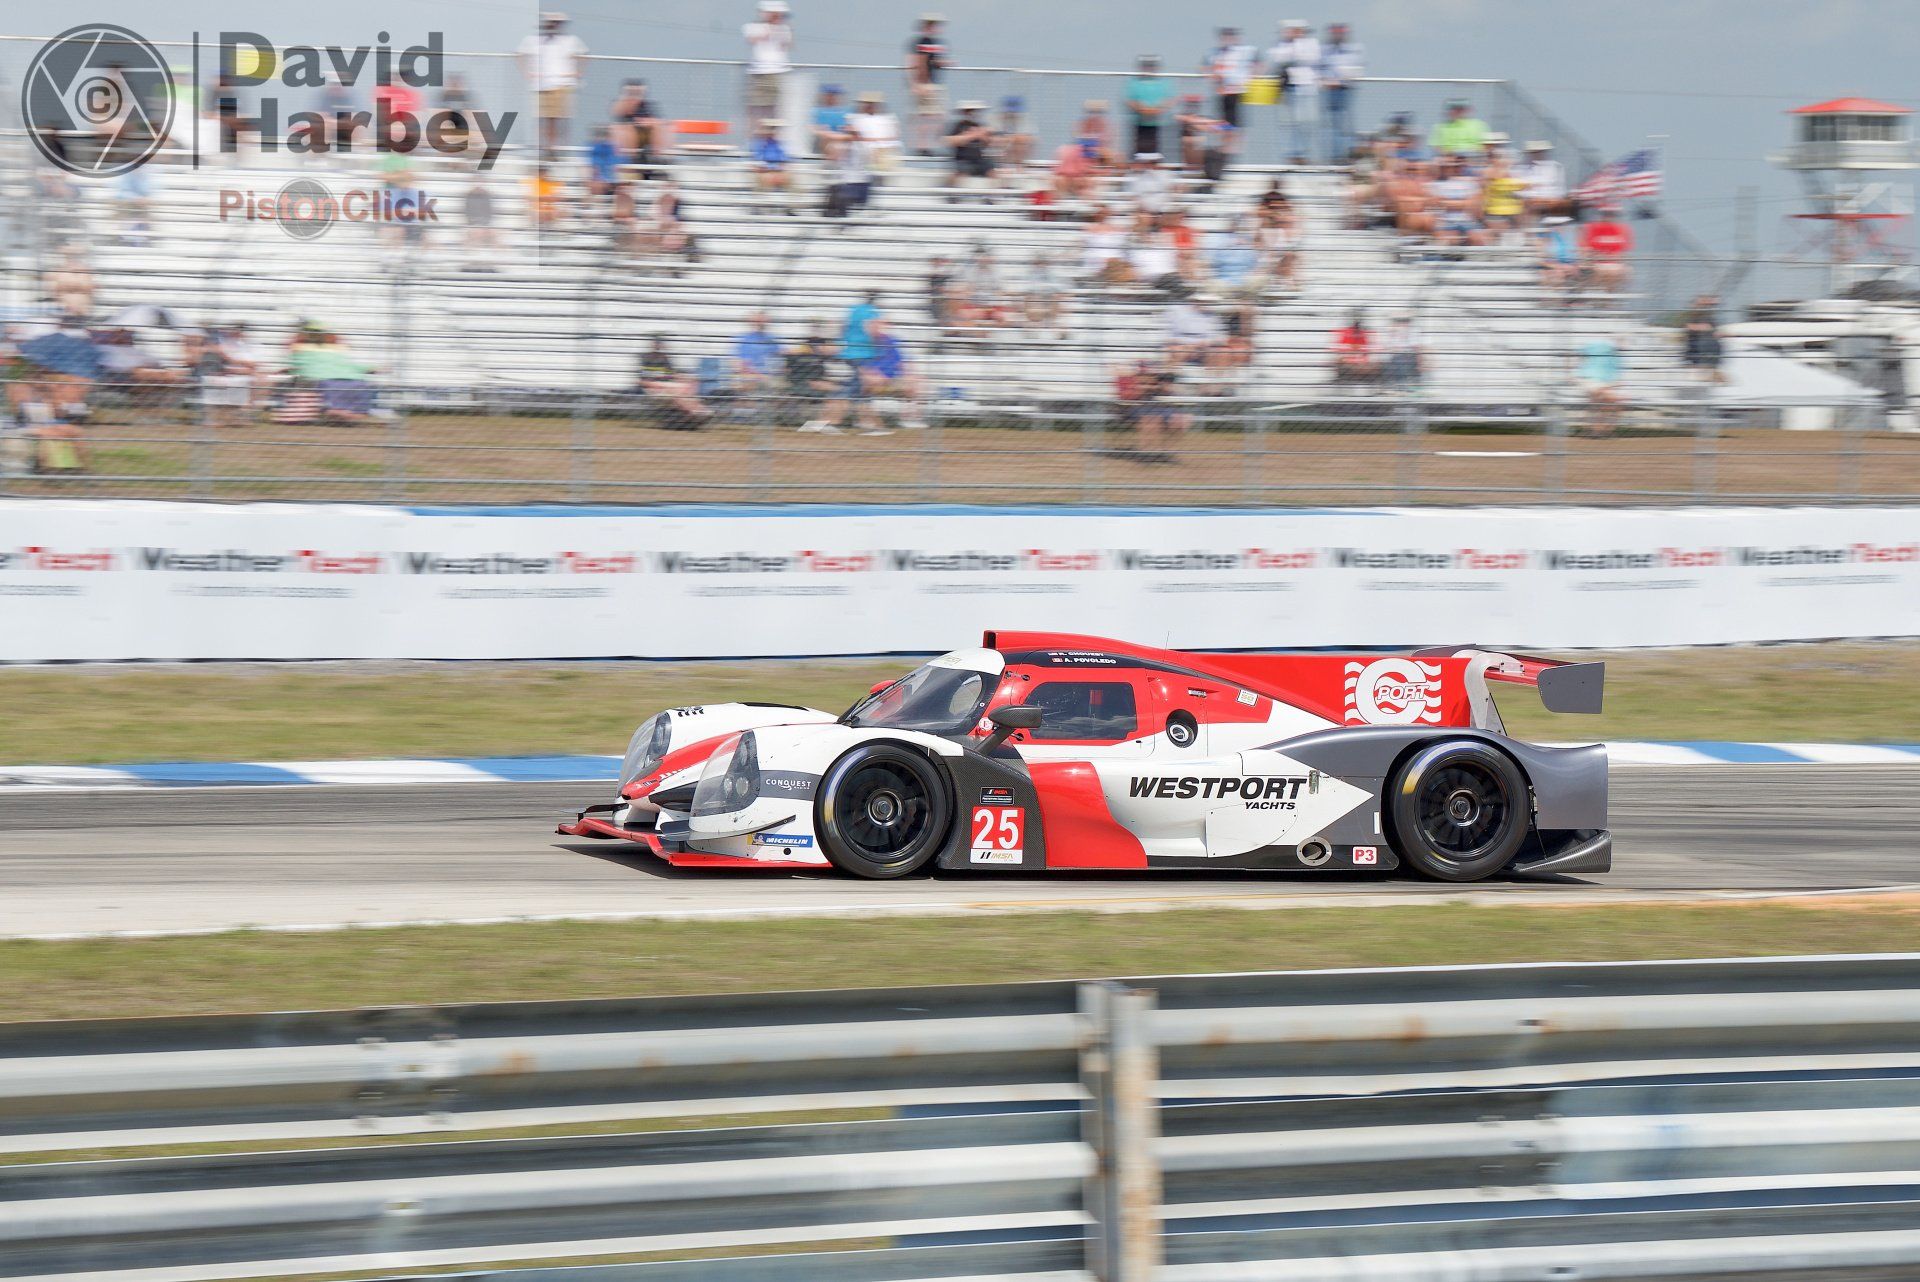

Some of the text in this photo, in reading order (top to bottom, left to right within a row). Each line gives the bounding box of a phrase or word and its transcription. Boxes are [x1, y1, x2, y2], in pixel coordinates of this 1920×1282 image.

[1377, 684, 1431, 701] PORT
[765, 779, 812, 790] CONQUEST
[1129, 776, 1307, 800] WESTPORT
[1244, 801, 1297, 810] YACHTS
[972, 809, 1019, 849] 25
[765, 837, 809, 845] MICHELIN
[1354, 849, 1375, 861] P3
